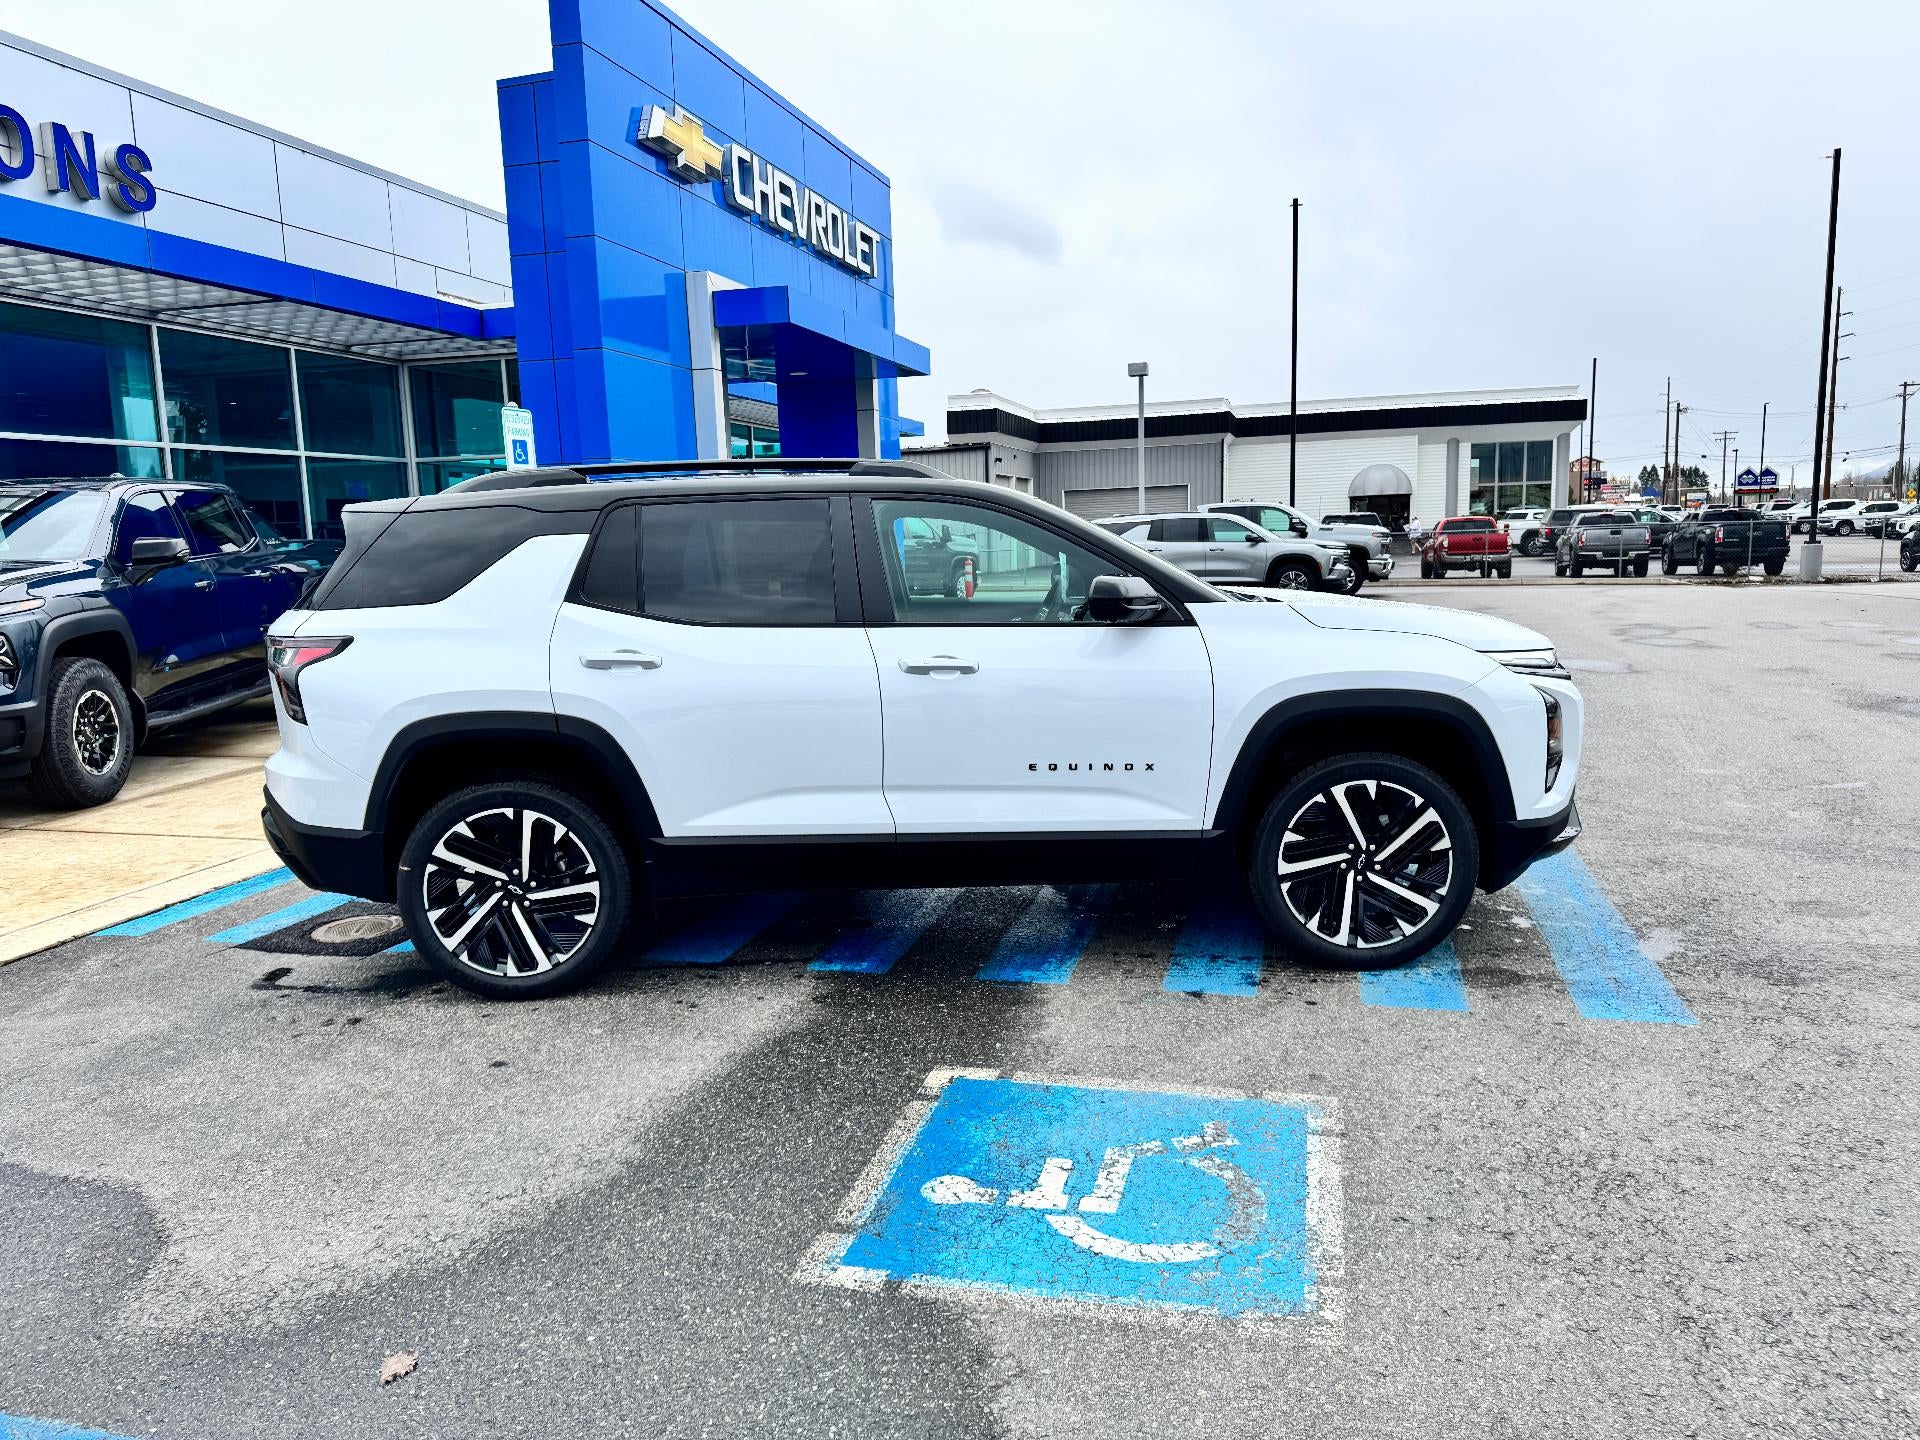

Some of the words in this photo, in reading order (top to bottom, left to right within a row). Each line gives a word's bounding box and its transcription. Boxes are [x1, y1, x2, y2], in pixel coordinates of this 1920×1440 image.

[724, 143, 880, 279] CHEVROLET
[507, 426, 530, 437] PARKING
[1028, 763, 1155, 772] EQUINOX
